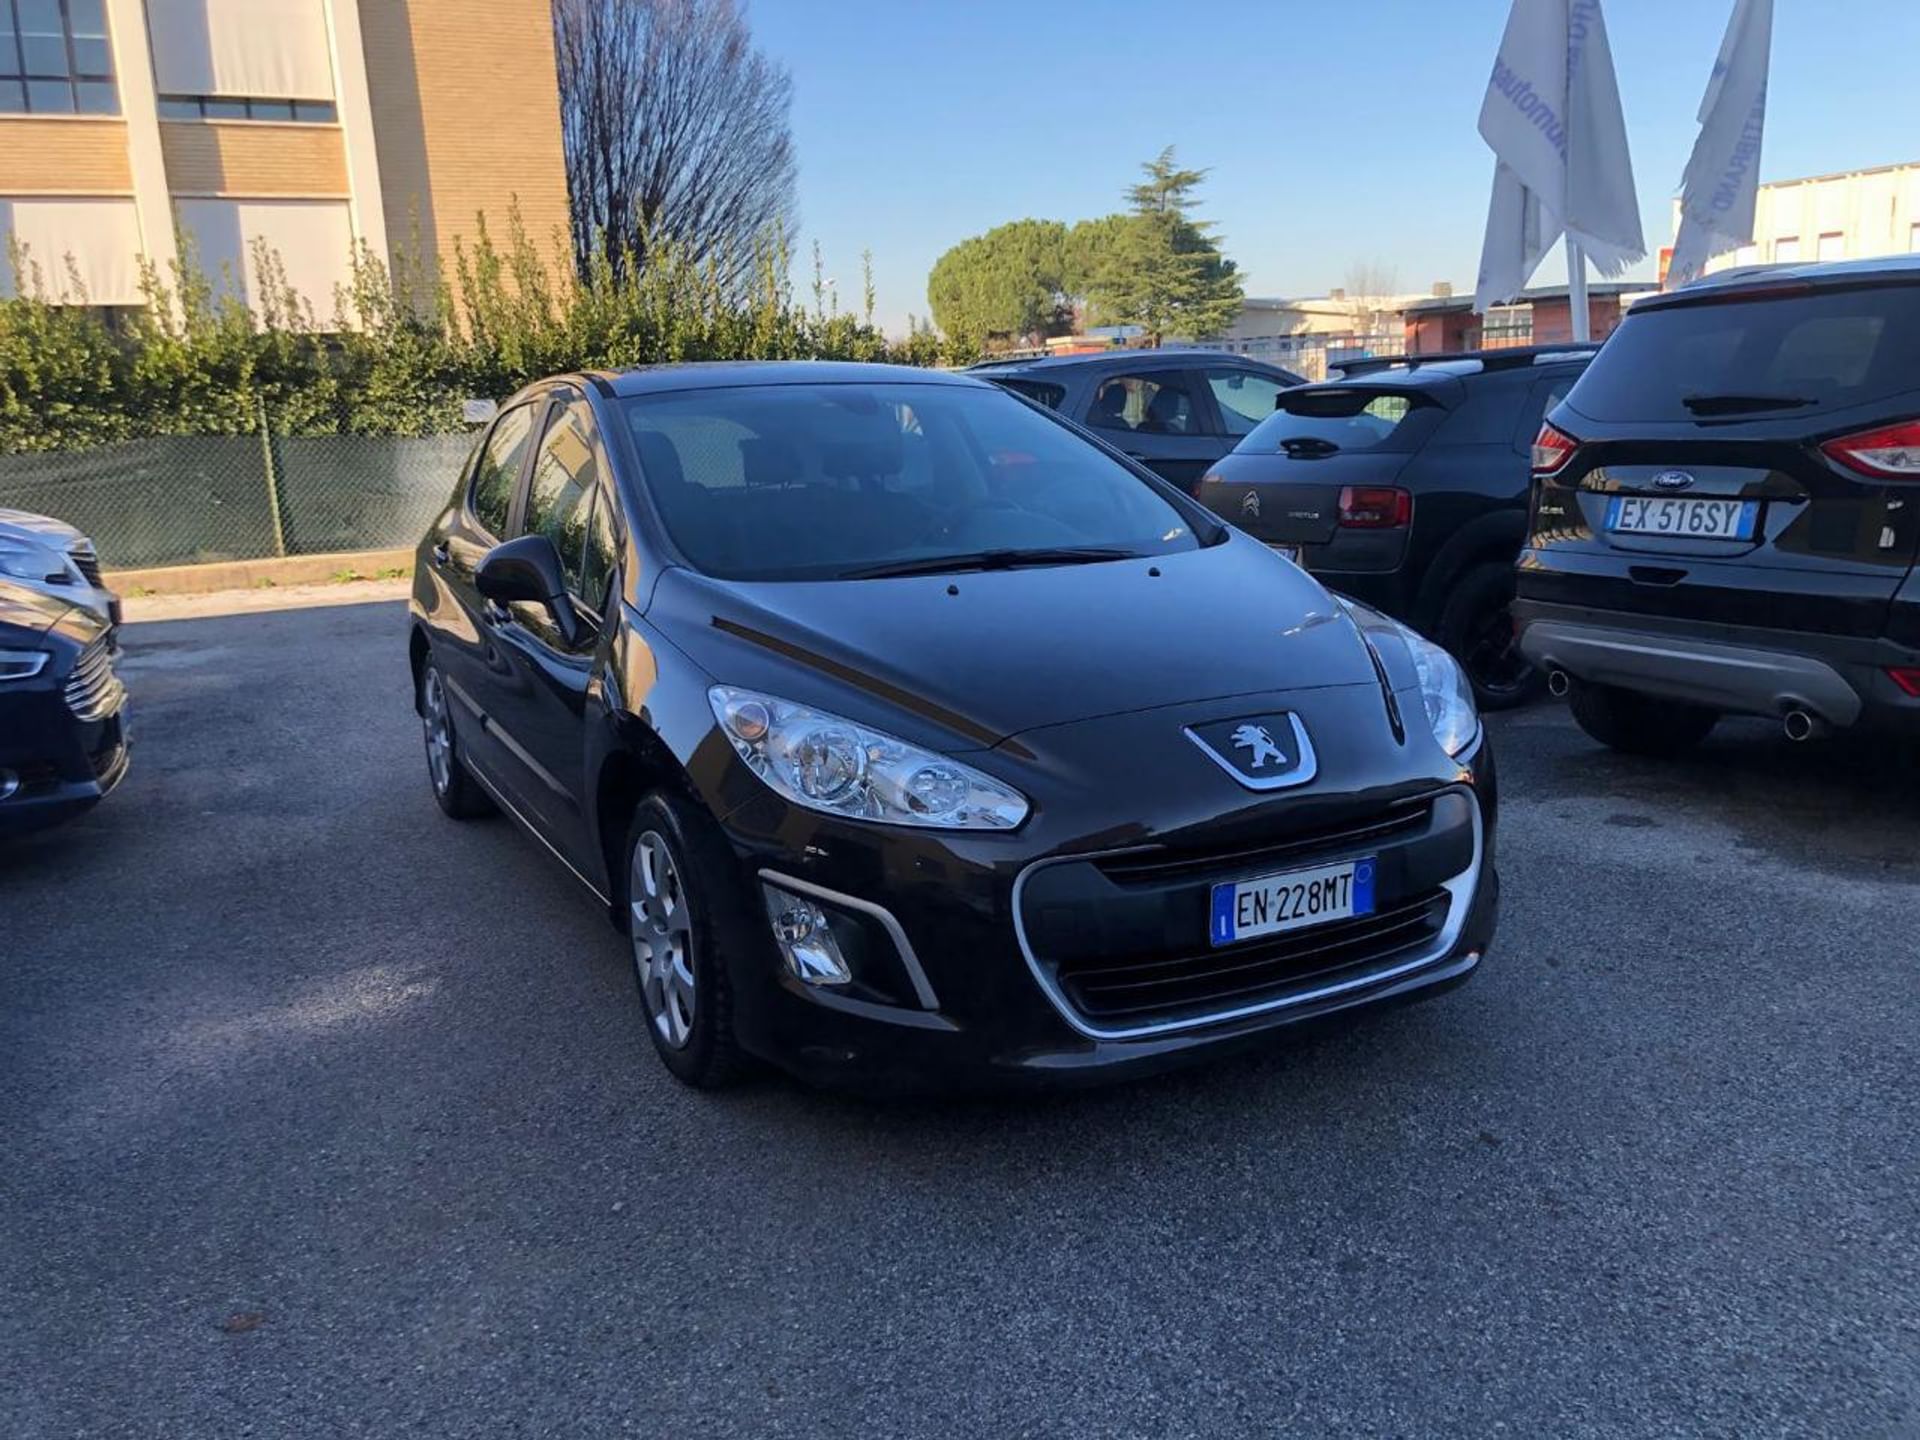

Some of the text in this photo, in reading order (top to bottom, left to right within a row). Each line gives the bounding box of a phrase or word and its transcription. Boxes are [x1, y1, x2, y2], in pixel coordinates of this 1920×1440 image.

[1619, 498, 1653, 529] EX
[1658, 500, 1739, 534] 516SY
[1237, 888, 1269, 928] EN
[1276, 873, 1353, 922] 228MT
